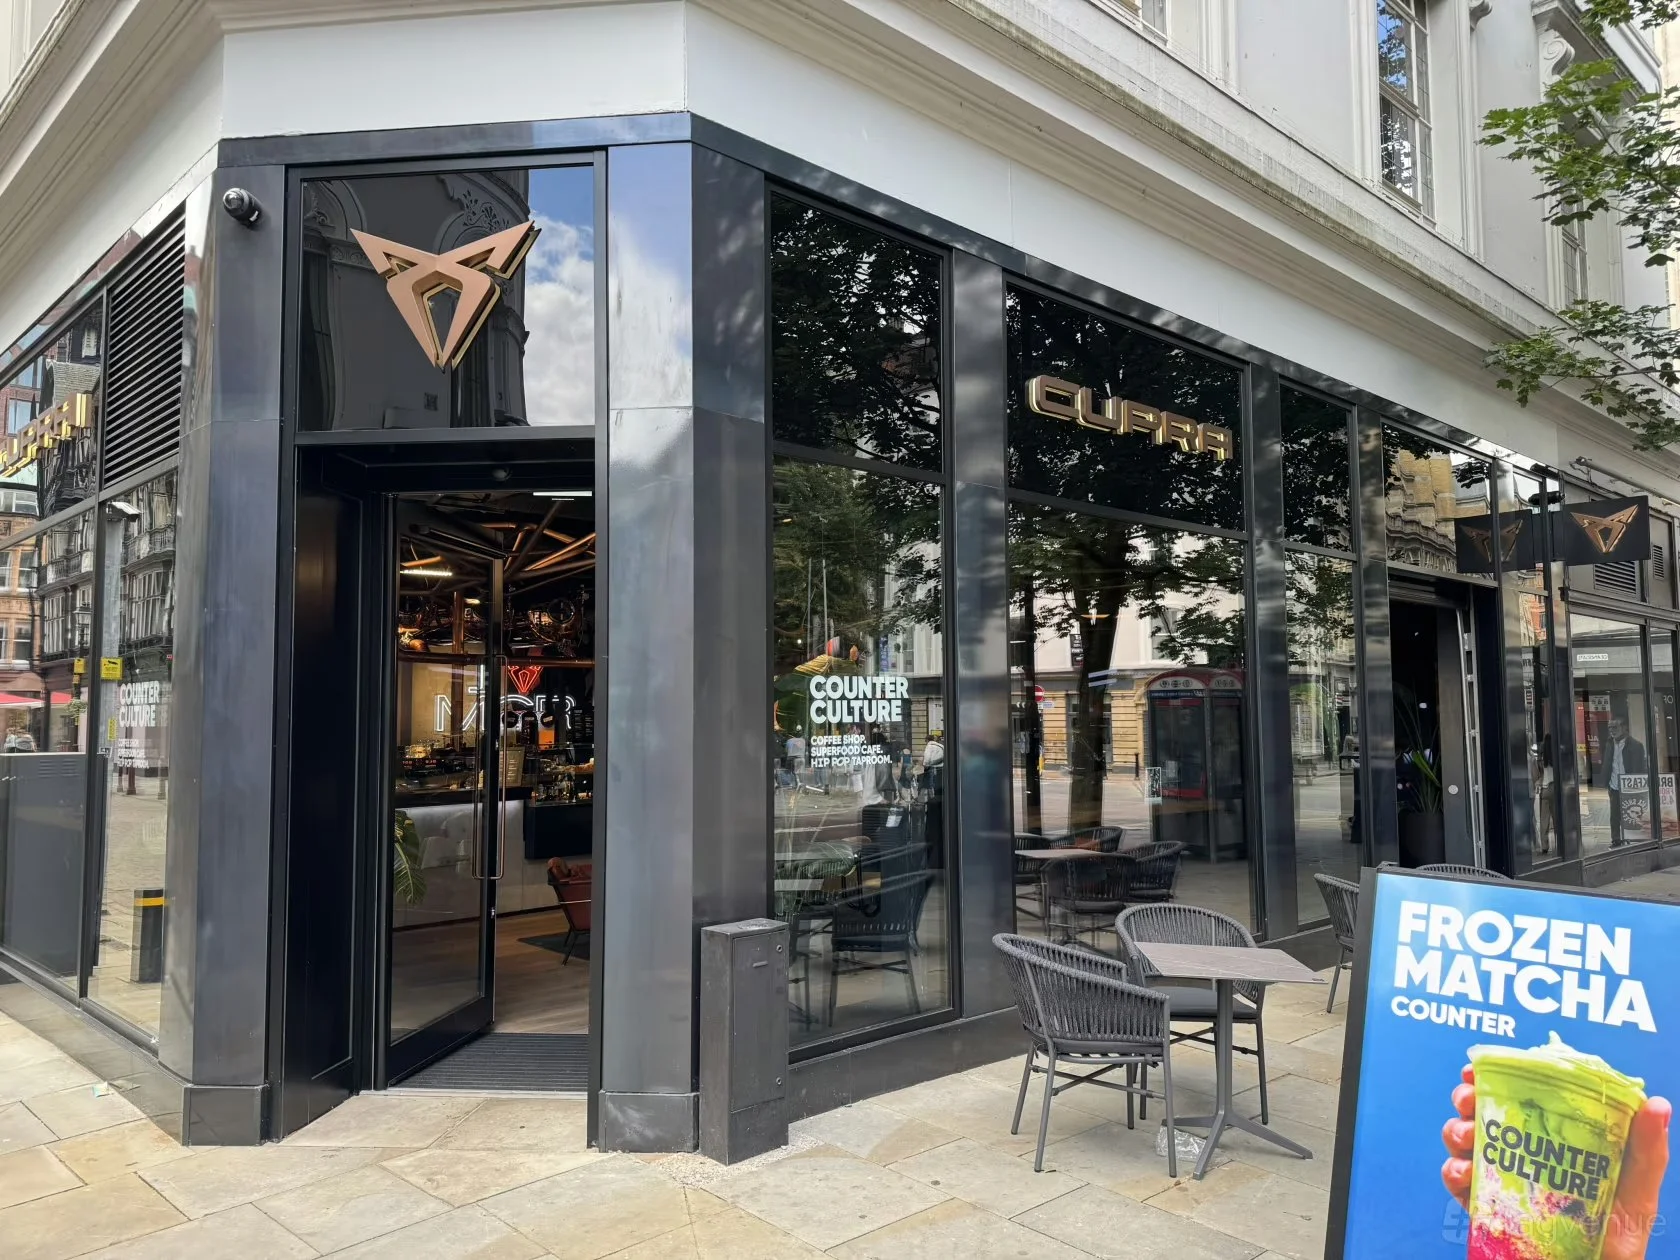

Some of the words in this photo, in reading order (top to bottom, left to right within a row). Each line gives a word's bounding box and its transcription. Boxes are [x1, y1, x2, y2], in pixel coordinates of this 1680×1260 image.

[1025, 374, 1233, 460] CUPRA
[119, 681, 159, 705] COUNTER
[809, 675, 909, 699] COUNTER
[118, 704, 156, 728] CULTURE
[809, 699, 903, 724] CULTURE
[810, 735, 842, 746] COFFEE
[843, 734, 867, 745] SHOP.
[810, 745, 860, 757] SUPERFOOD
[860, 744, 884, 754] CAFE.
[810, 758, 829, 769] HIP
[831, 757, 850, 768] POP
[852, 755, 893, 766] TAPROOM.
[1398, 899, 1632, 976] FROZEN
[1393, 945, 1657, 1033] MATCHA
[1390, 995, 1516, 1039] COUNTER
[1484, 1118, 1610, 1180] COUNTER
[1482, 1142, 1601, 1202] CULTURE
